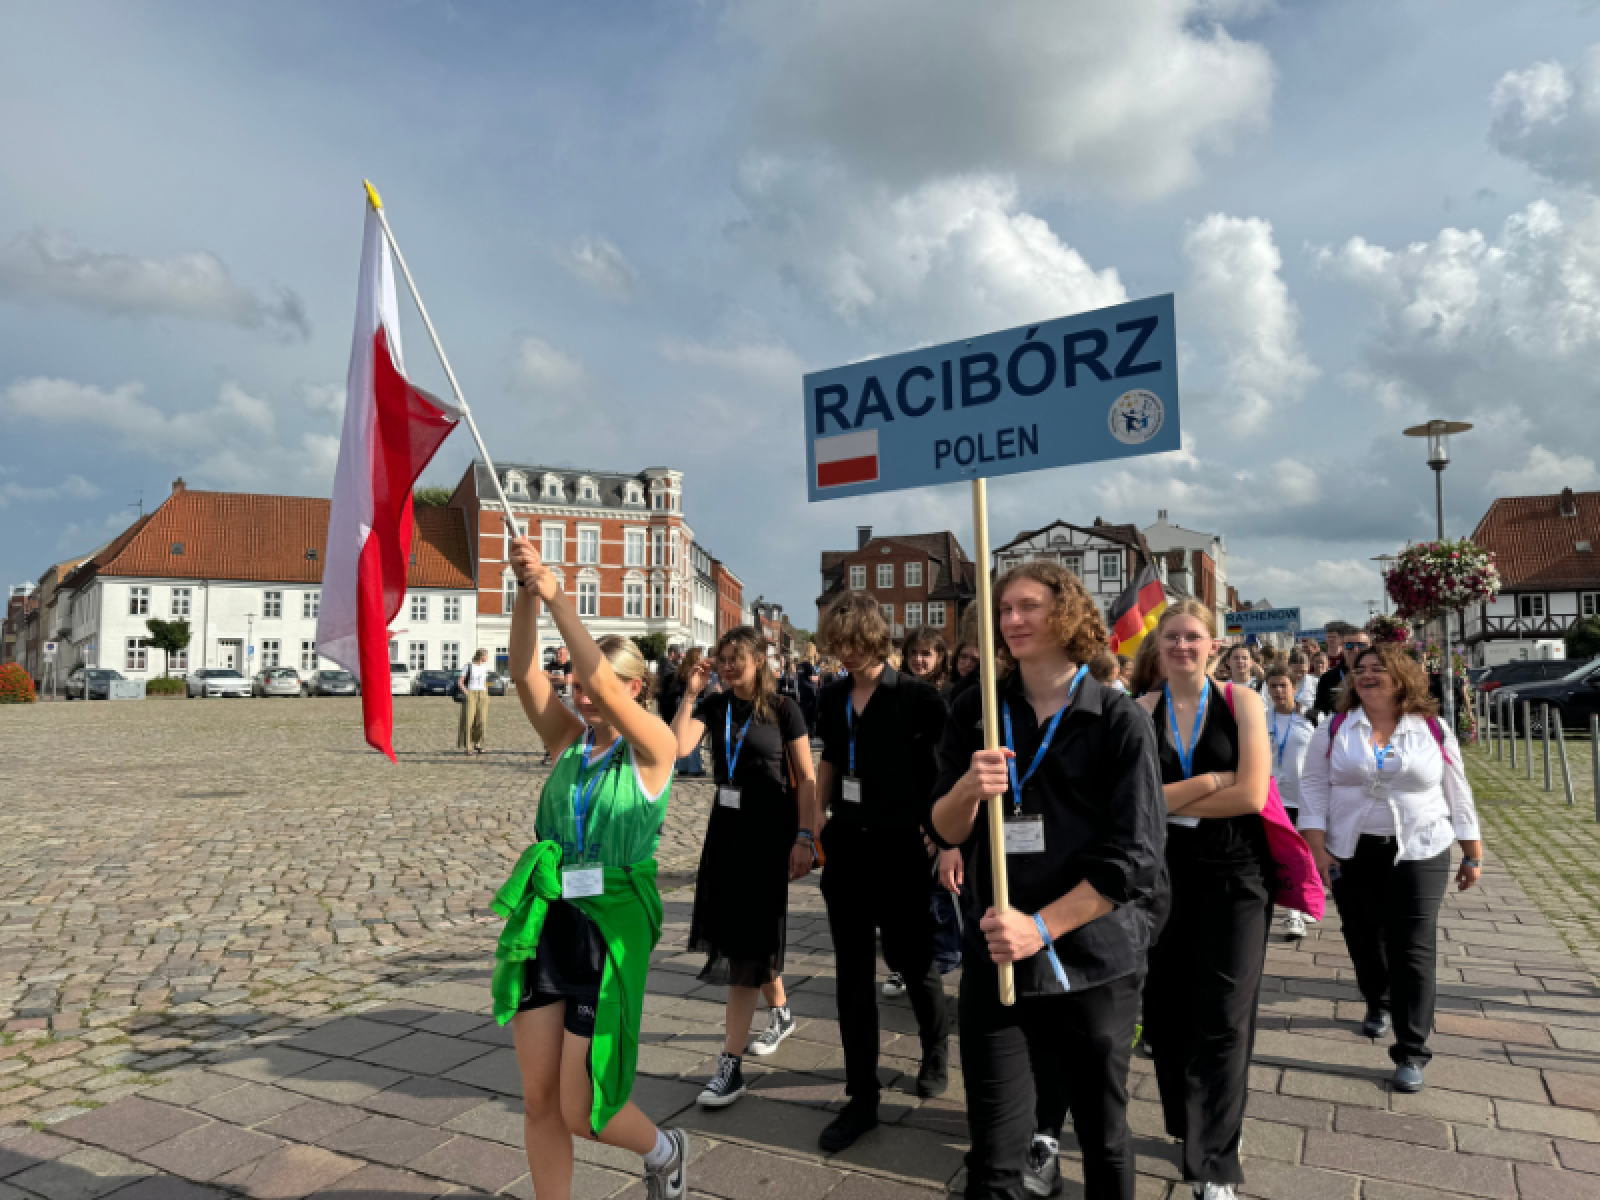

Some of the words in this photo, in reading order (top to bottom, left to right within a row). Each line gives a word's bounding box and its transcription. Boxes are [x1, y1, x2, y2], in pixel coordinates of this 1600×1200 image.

[815, 315, 1162, 434] RACIBÓRZ
[935, 423, 1039, 469] POLEN
[1226, 610, 1297, 623] RATHENOW
